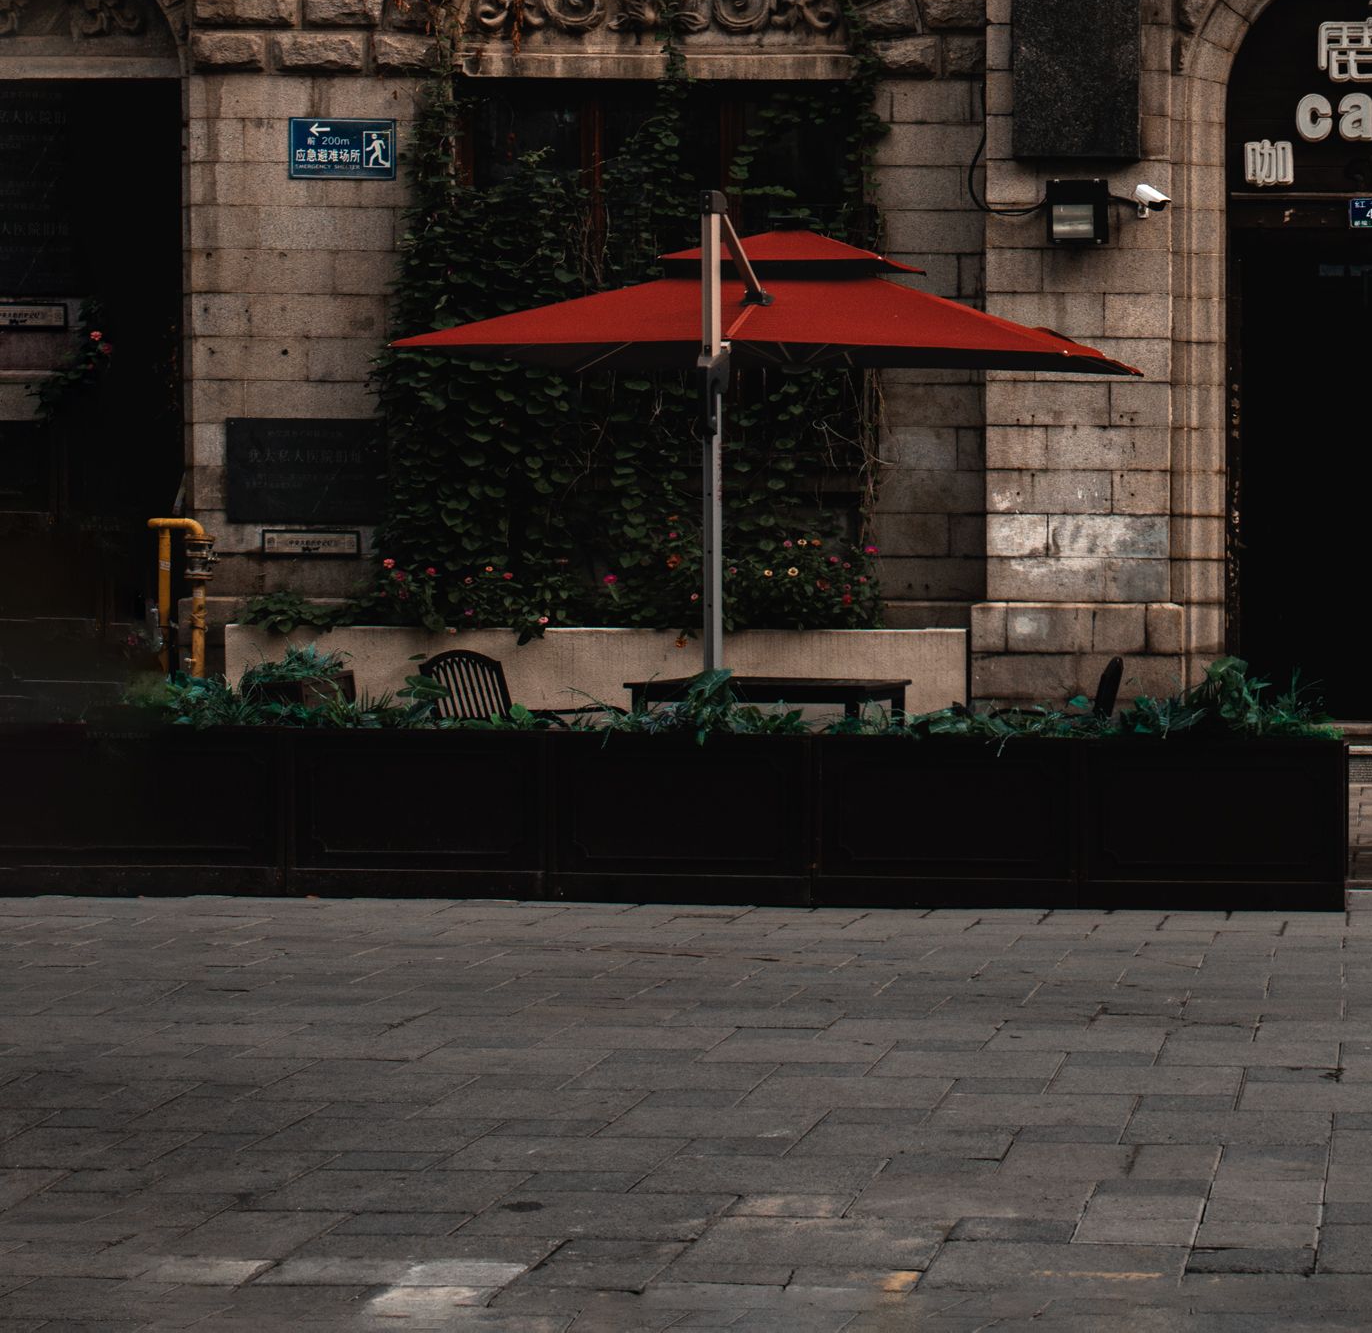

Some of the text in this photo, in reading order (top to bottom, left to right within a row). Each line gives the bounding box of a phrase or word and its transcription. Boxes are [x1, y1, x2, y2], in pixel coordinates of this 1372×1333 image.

[322, 136, 350, 146] 200m
[295, 149, 361, 162] 应急避难场所
[1245, 139, 1294, 187] 咖
